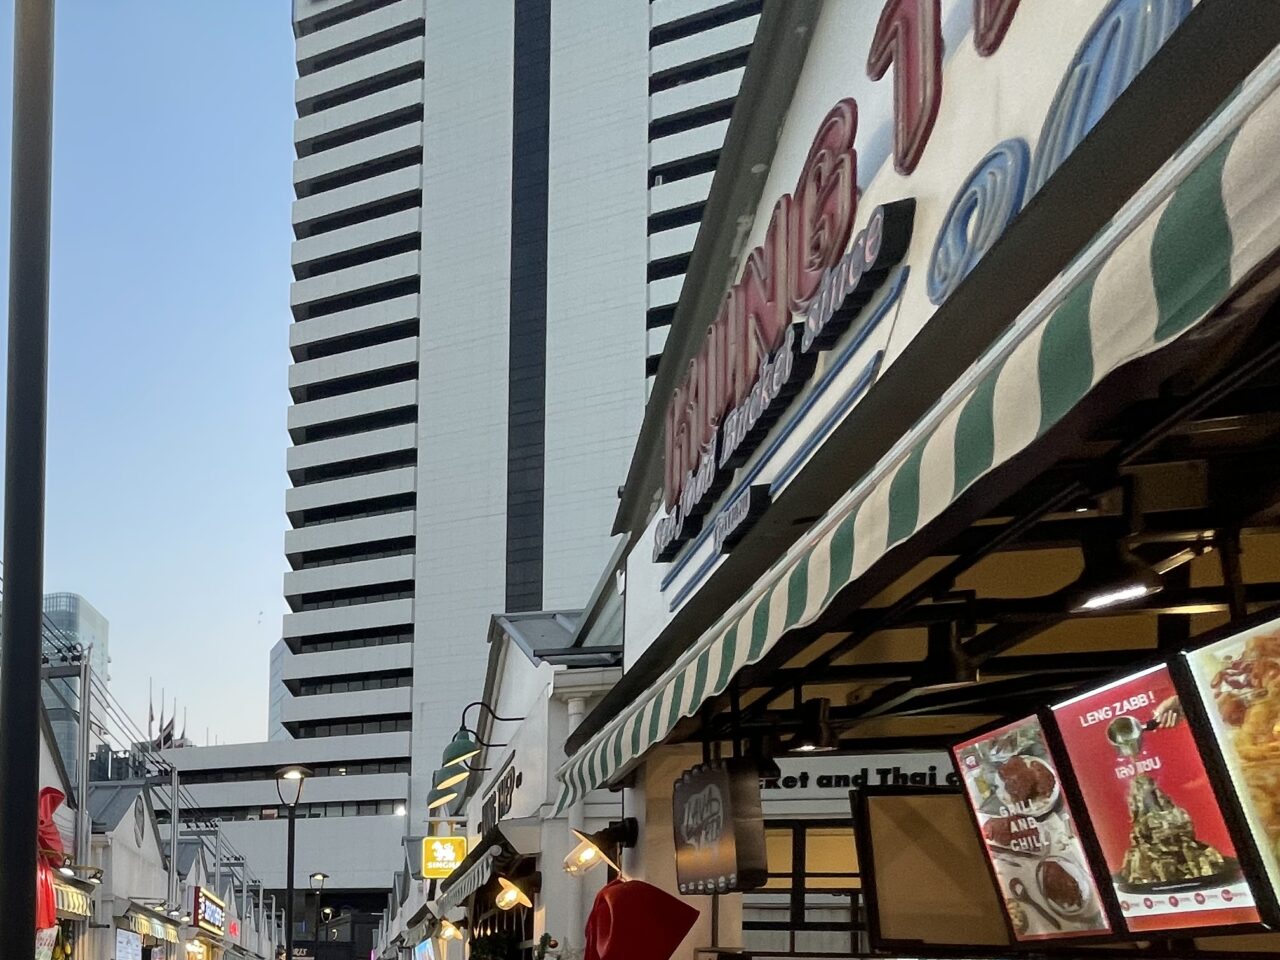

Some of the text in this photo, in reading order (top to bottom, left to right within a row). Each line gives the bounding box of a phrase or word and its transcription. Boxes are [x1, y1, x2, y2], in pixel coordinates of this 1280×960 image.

[1079, 707, 1112, 727] LENG
[817, 768, 868, 788] and
[875, 765, 937, 787] Thai
[1010, 816, 1038, 833] AND
[1010, 835, 1050, 851] CHILL
